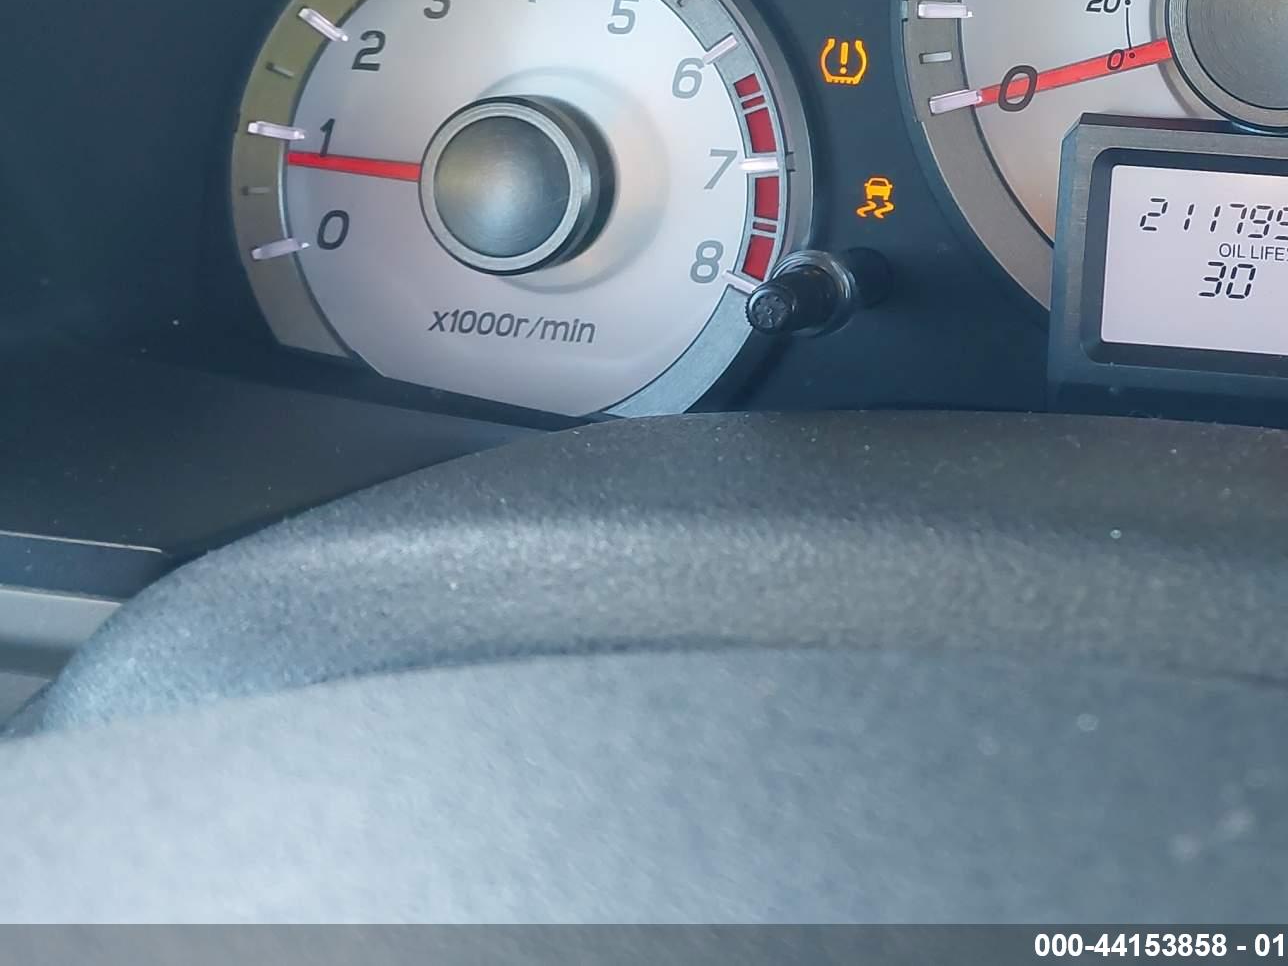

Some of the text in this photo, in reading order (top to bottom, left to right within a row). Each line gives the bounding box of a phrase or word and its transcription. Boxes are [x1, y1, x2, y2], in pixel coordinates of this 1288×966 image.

[351, 30, 387, 71] 2
[1107, 49, 1125, 71] 0
[672, 57, 702, 98] 6
[999, 66, 1039, 112] 0
[319, 118, 335, 158] 1
[703, 149, 738, 190] 7
[317, 209, 349, 250] 0
[689, 240, 723, 284] 8
[1219, 242, 1246, 259] OIL
[1199, 261, 1256, 299] 30
[428, 308, 595, 344] x1000r/min
